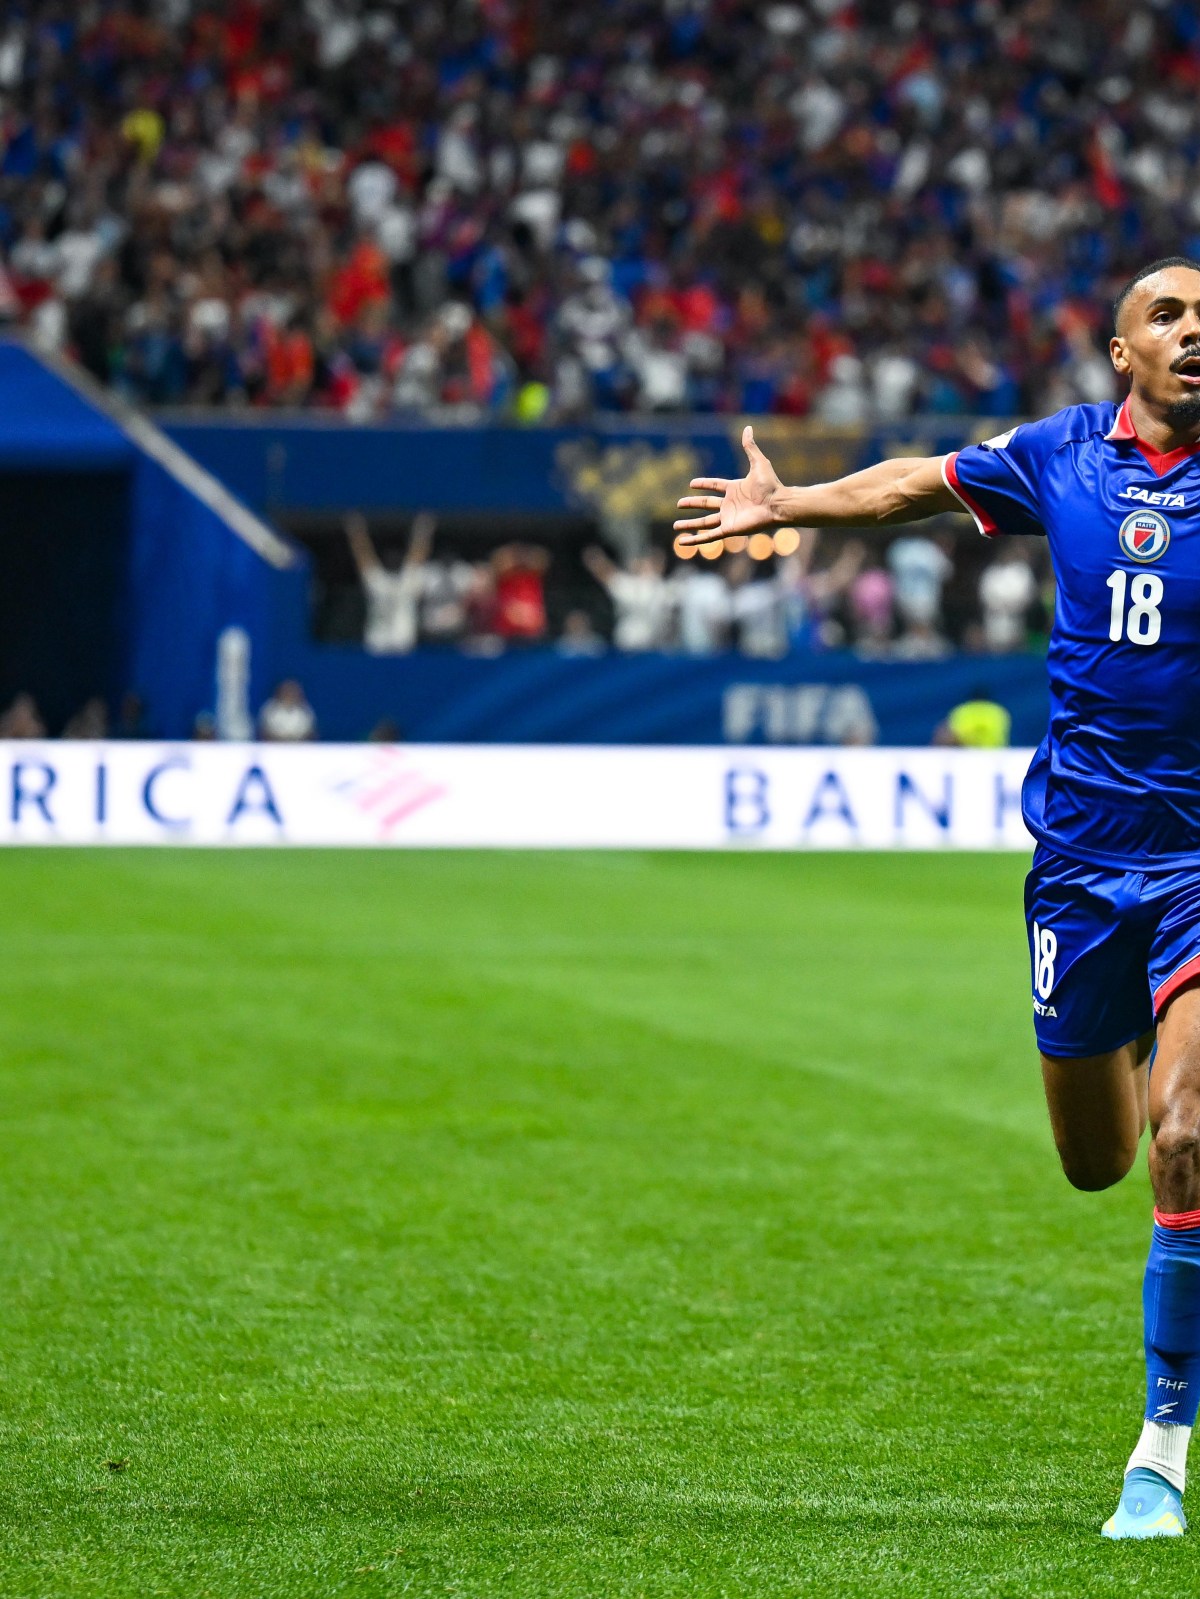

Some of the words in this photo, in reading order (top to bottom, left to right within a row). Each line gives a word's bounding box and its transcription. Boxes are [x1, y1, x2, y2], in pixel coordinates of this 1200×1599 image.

[1118, 486, 1185, 507] SAETA
[1137, 521, 1156, 529] HAITI
[1106, 569, 1164, 646] 18
[722, 682, 878, 746] FIFA
[11, 757, 284, 829] RICA
[1033, 920, 1057, 1000] 18
[1157, 1377, 1188, 1391] FHF
